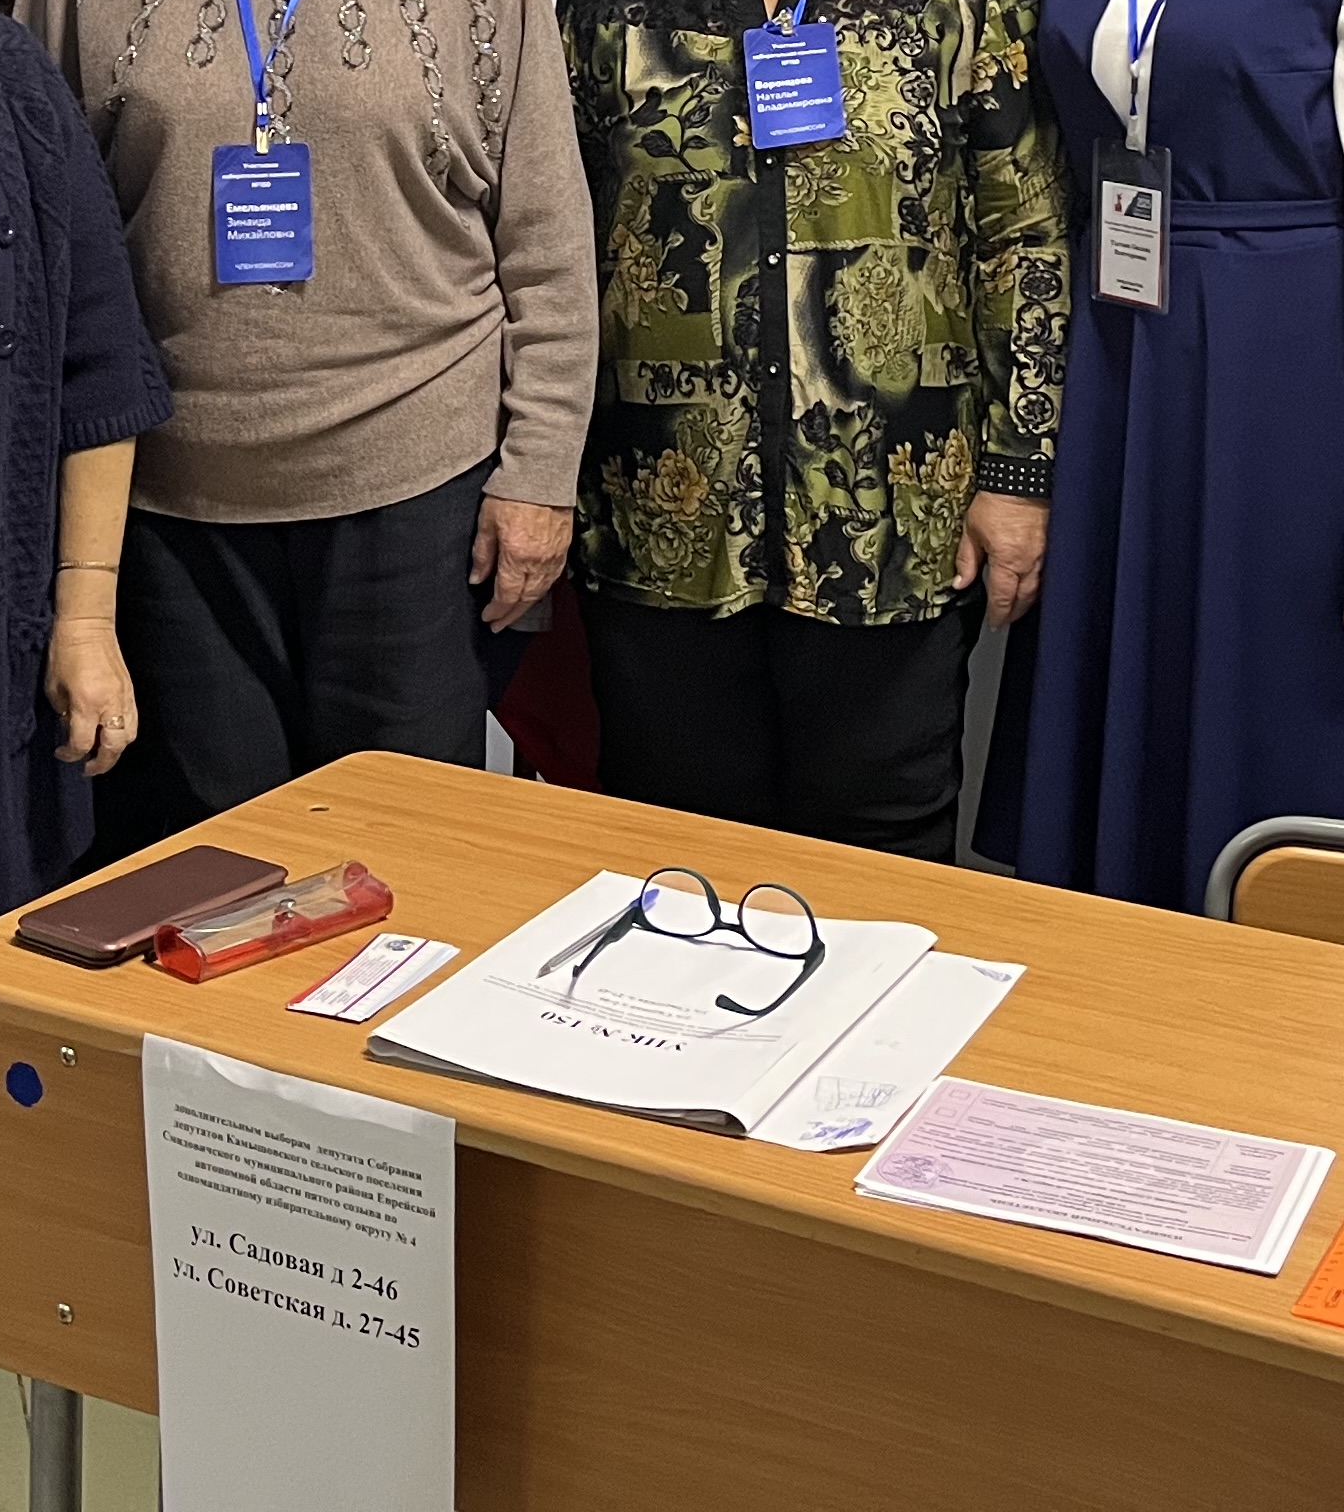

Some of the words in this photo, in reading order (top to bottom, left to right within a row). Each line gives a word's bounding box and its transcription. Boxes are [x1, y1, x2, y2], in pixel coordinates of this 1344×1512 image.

[756, 90, 799, 102] Наталья
[757, 96, 833, 113] Владимировна
[225, 201, 299, 214] Емельянцева
[226, 216, 272, 228] Зинаида
[227, 229, 295, 241] Михайловна
[540, 1010, 582, 1029] 150
[173, 1119, 224, 1141] депутатов
[226, 1133, 308, 1165] Камышовского
[310, 1159, 364, 1181] сельского
[366, 1175, 422, 1198] поселения
[174, 1103, 261, 1136] дополнительным
[264, 1130, 311, 1151] выборам
[316, 1145, 364, 1166] депутата
[367, 1157, 422, 1180] Собрания
[162, 1129, 241, 1163] Смидовичского
[243, 1156, 333, 1189] муниципального
[335, 1183, 374, 1201] района
[377, 1192, 436, 1218] Еврейской
[194, 1160, 257, 1185] автономной
[260, 1177, 302, 1197] области
[304, 1190, 341, 1208] пятого
[343, 1202, 382, 1220] созыва
[177, 1170, 263, 1205] одномандатному
[265, 1195, 352, 1230] избирательному
[354, 1222, 392, 1242] округу
[190, 1225, 222, 1249] ул.
[229, 1232, 324, 1279] Садовая
[331, 1268, 344, 1287] д
[351, 1268, 398, 1301] 2-46
[173, 1257, 201, 1283] ул.
[207, 1267, 325, 1321] Советская
[331, 1309, 352, 1330] д.
[359, 1313, 421, 1349] 27-45
